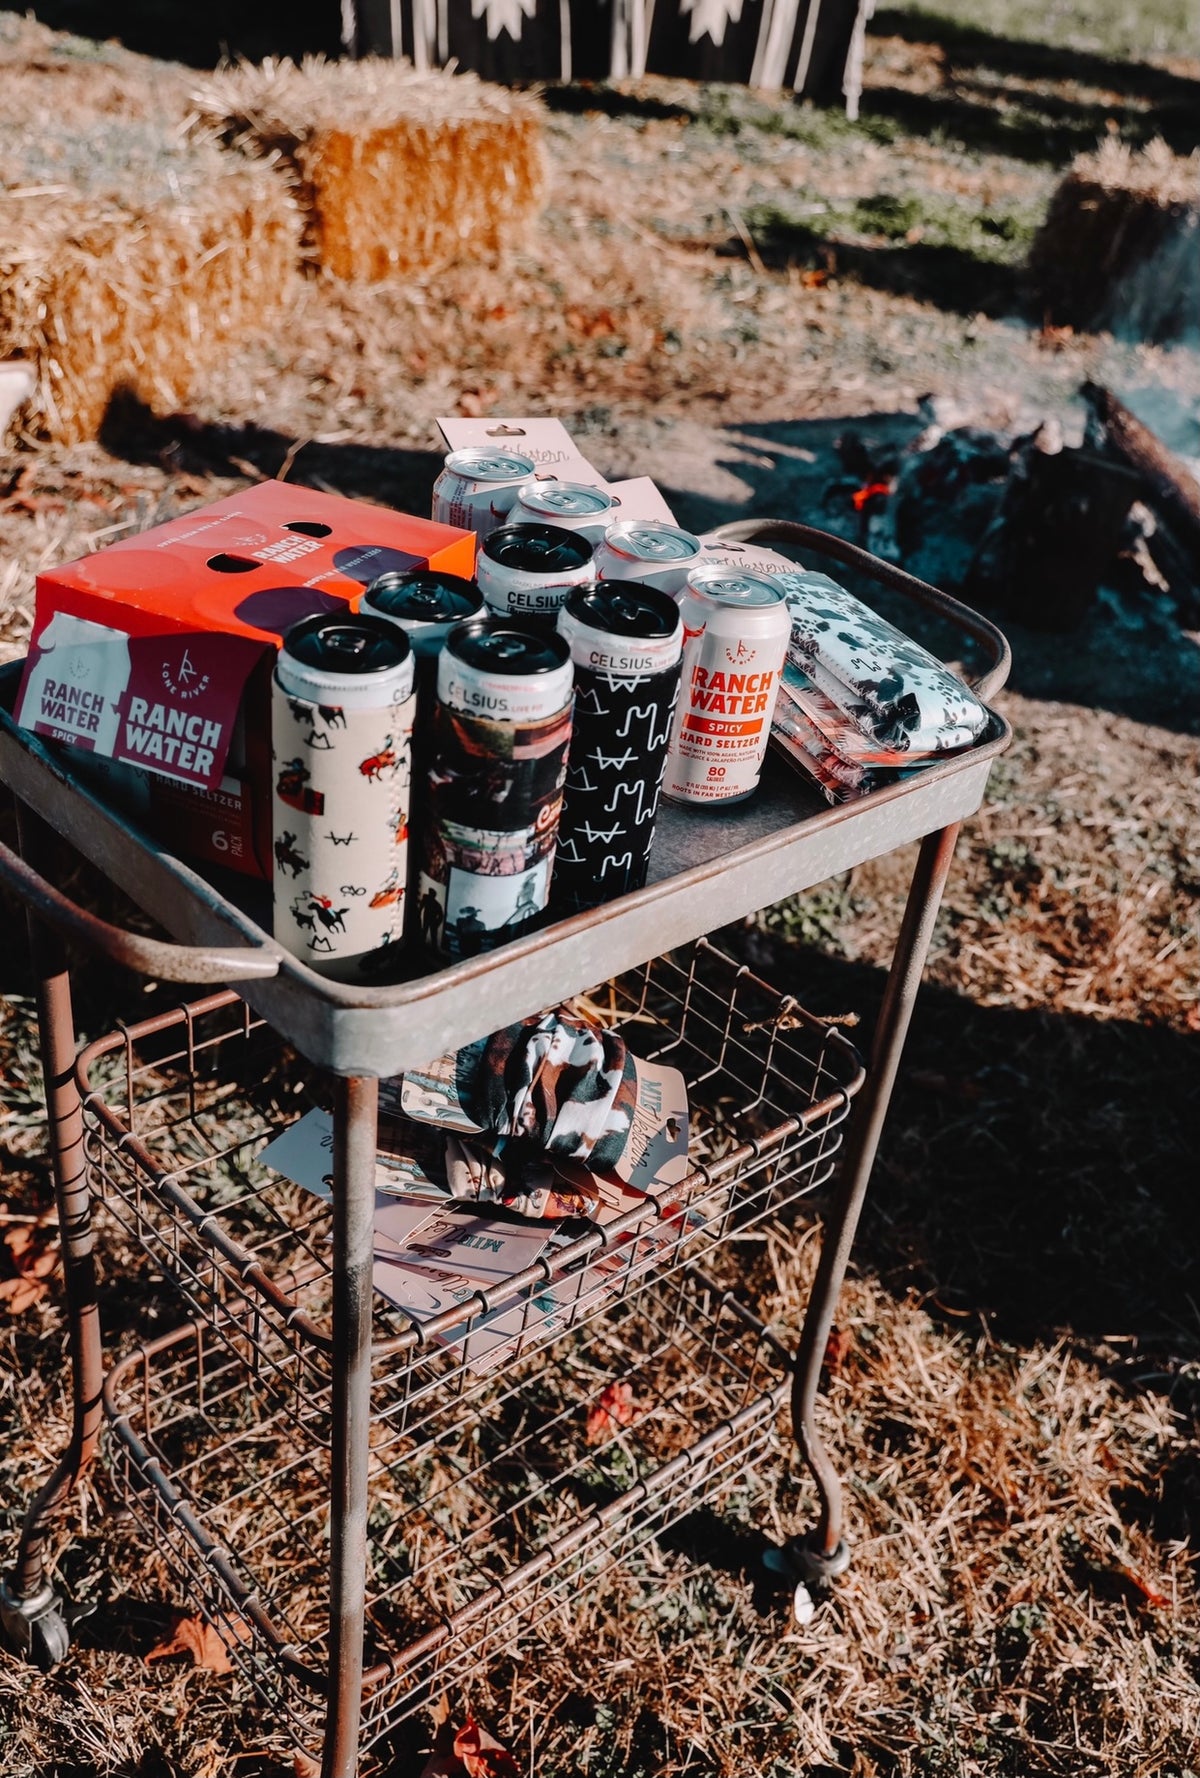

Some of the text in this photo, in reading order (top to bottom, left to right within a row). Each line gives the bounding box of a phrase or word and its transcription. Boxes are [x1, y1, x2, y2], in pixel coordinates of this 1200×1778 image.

[251, 535, 307, 559] RANCH
[268, 540, 325, 564] WATER
[589, 651, 653, 670] CELSIUS
[162, 663, 210, 698] LONE RIVER
[692, 665, 774, 694] RANCH
[42, 678, 105, 714] RANCH
[690, 688, 769, 715] WATER
[41, 697, 100, 733] WATER
[127, 696, 223, 749] RANCH
[52, 729, 78, 744] SPICY
[708, 722, 743, 733] SPICY
[126, 723, 215, 776] WATER
[680, 731, 760, 749] HARD SELTZER
[709, 766, 726, 777] 80
[193, 786, 242, 811] SELTZER
[672, 784, 692, 794] ROOTS
[211, 830, 229, 851] 6
[231, 834, 244, 858] PACK
